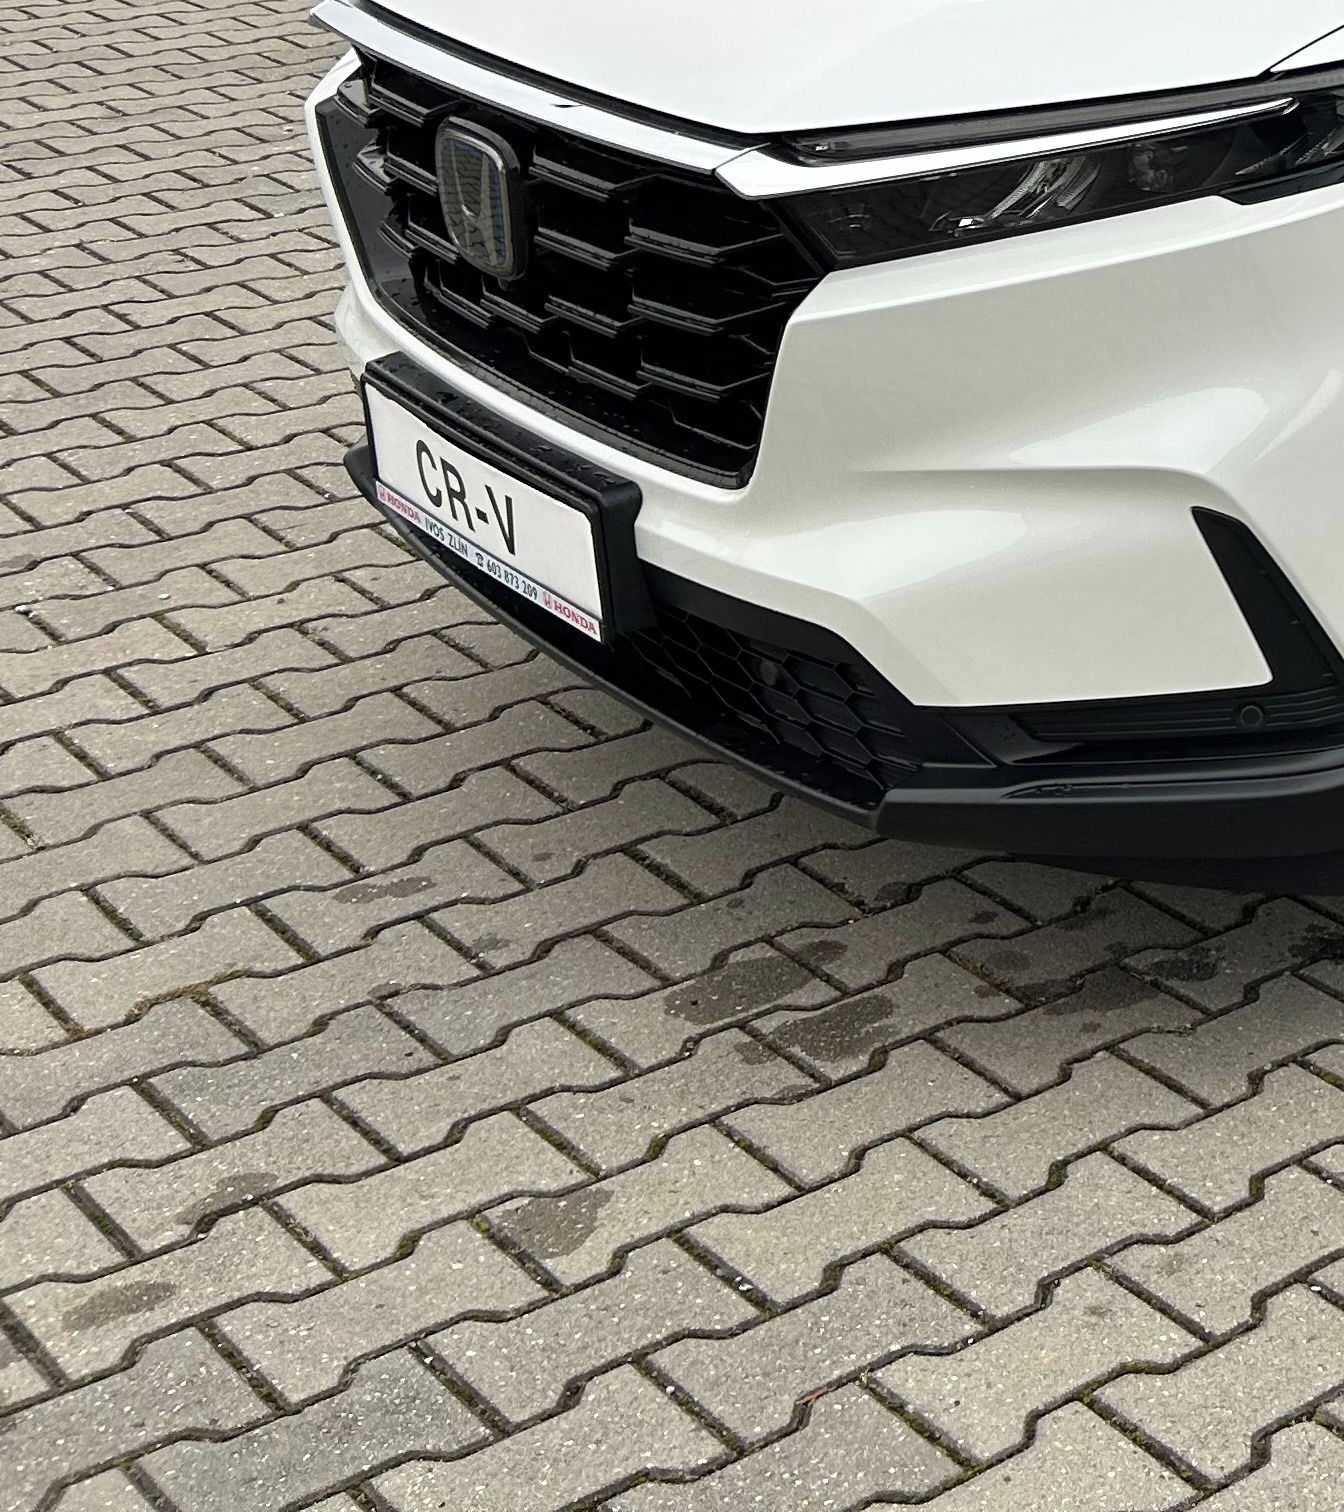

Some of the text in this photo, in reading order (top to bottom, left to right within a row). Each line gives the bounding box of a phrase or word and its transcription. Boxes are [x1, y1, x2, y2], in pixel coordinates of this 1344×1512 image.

[416, 439, 517, 556] CR-V
[386, 494, 598, 635] HONDA IVOS ZLÍN 603 873 209 HONDA
